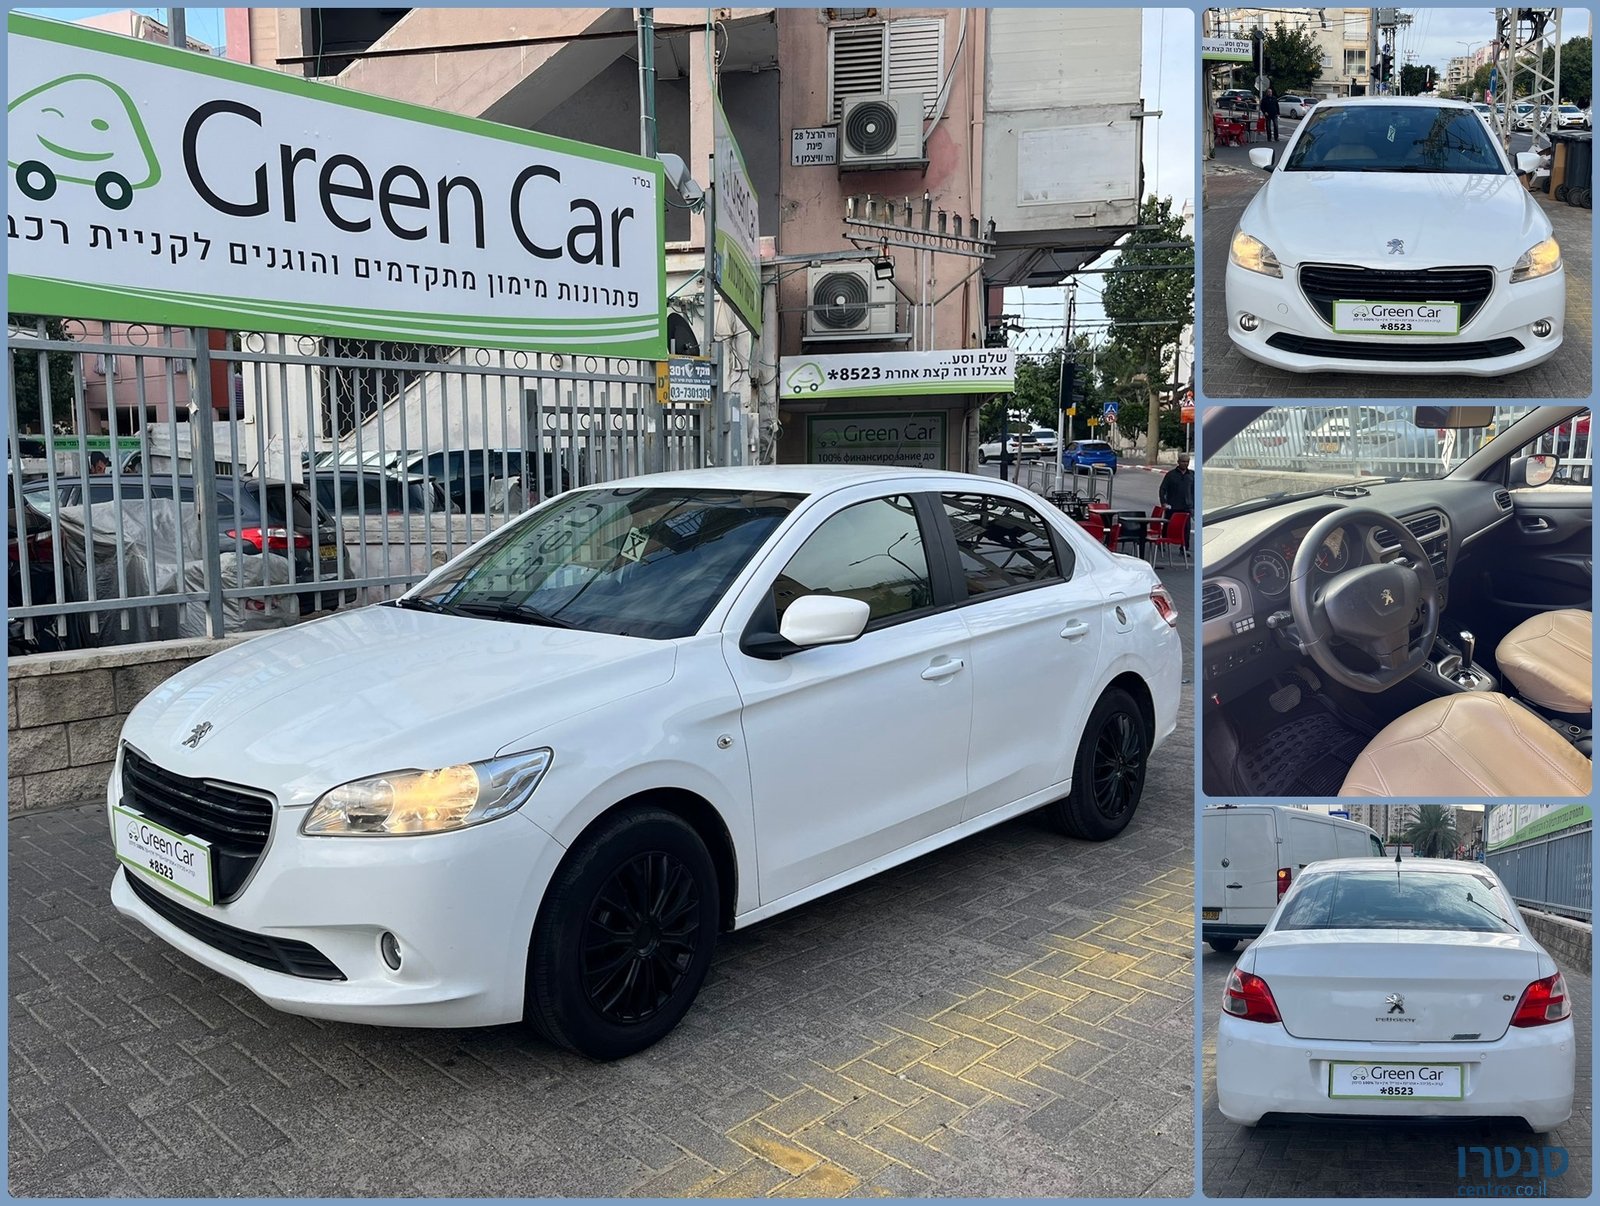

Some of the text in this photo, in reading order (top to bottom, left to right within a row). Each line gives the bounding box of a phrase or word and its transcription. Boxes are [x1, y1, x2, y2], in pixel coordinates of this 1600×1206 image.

[795, 132, 804, 140] 28
[805, 130, 826, 139] הרצל
[806, 142, 823, 150] פינת
[795, 155, 800, 163] 1
[182, 100, 485, 249] Green
[510, 164, 634, 268] Car
[8, 214, 639, 308] פתרונות מימון מתקדמים והוגנים לקניית רכב
[1371, 304, 1441, 318] Green Car
[978, 352, 1007, 363] שלם
[670, 366, 685, 376] 301
[884, 369, 918, 379] אחרת
[922, 367, 949, 380] קצת
[953, 366, 967, 376] זה
[971, 365, 1007, 377] אצלנו
[670, 387, 711, 399] 03-7301301
[843, 423, 936, 442] Green Car
[818, 453, 842, 463] 100%
[922, 452, 935, 462] до
[140, 825, 173, 857] Green
[174, 841, 195, 867] Car
[1371, 1066, 1444, 1080] Green Car
